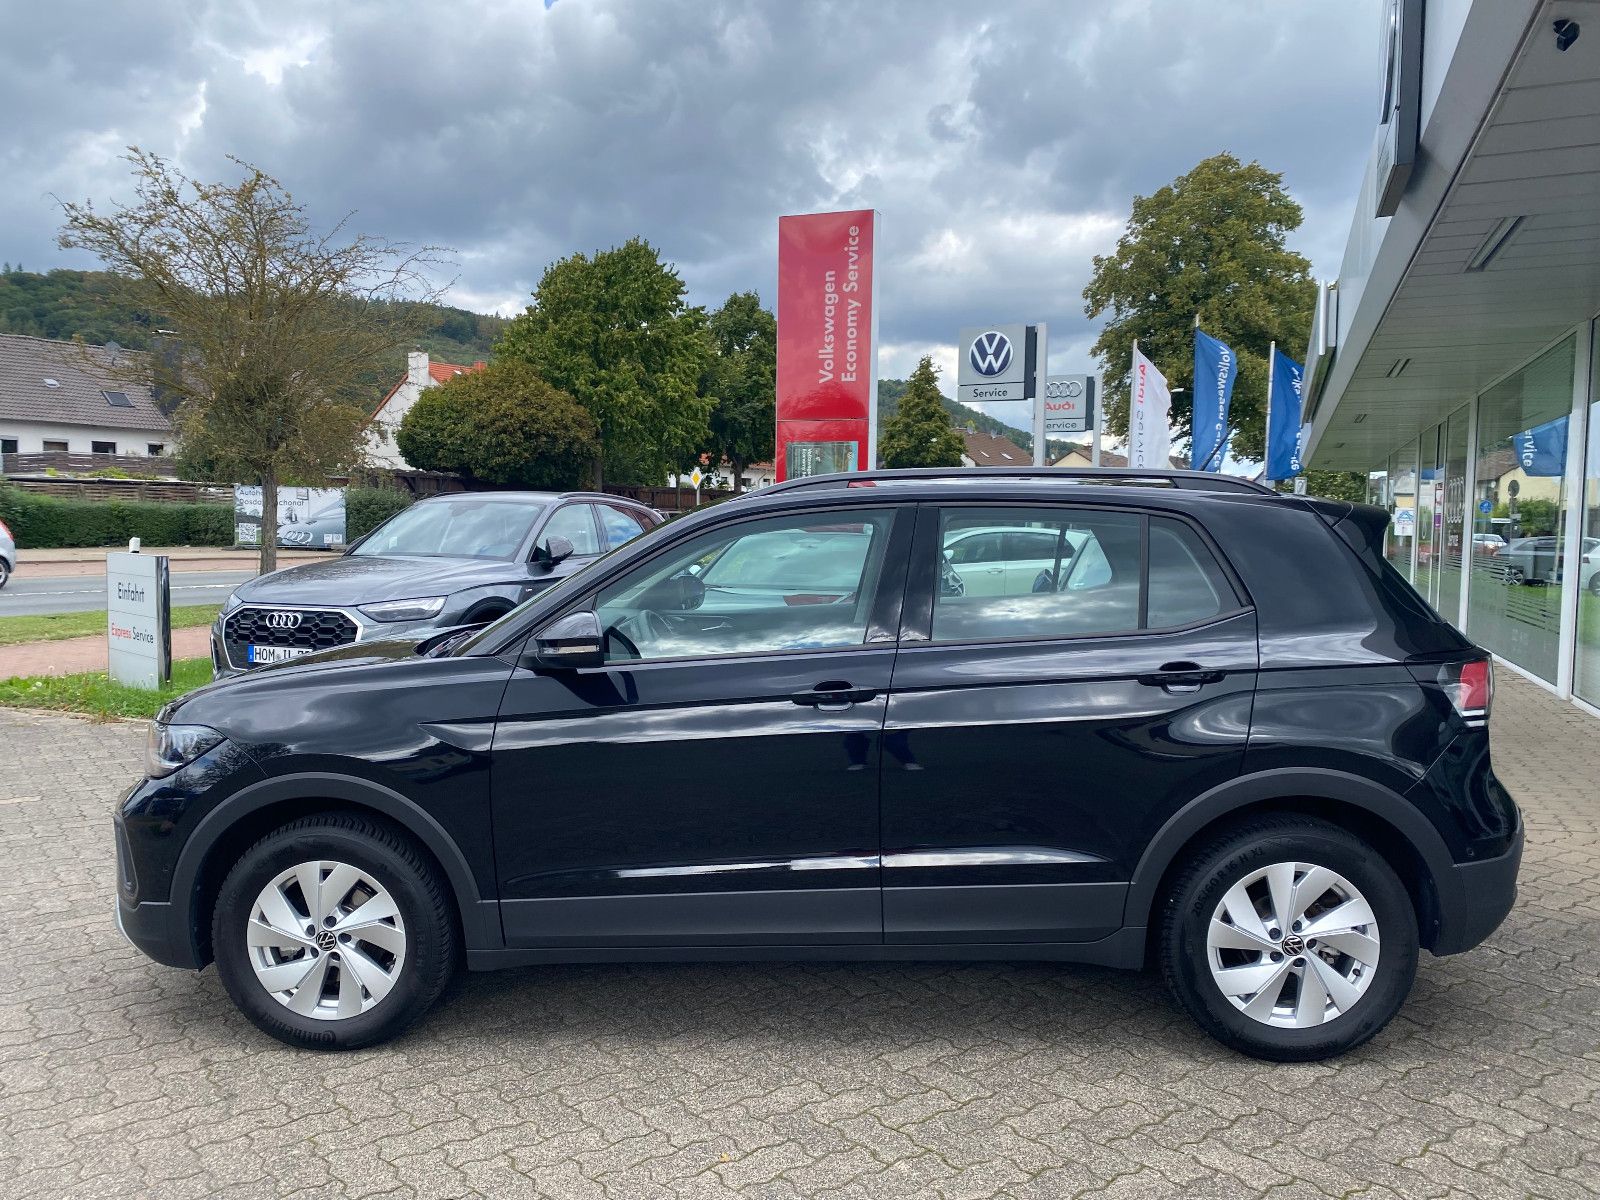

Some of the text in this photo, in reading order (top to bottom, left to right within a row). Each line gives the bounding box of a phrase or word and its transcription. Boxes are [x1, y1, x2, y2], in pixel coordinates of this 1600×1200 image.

[841, 225, 862, 382] Economy Service
[818, 270, 839, 384] Volkswagen
[970, 331, 1013, 377] VW
[973, 388, 1008, 398] Service
[1045, 401, 1075, 411] Audi
[1046, 421, 1077, 429] ervice
[1522, 430, 1537, 467] ervice
[117, 581, 145, 603] Einfahrt
[111, 622, 154, 644] Express Service
[254, 647, 275, 661] HOM
